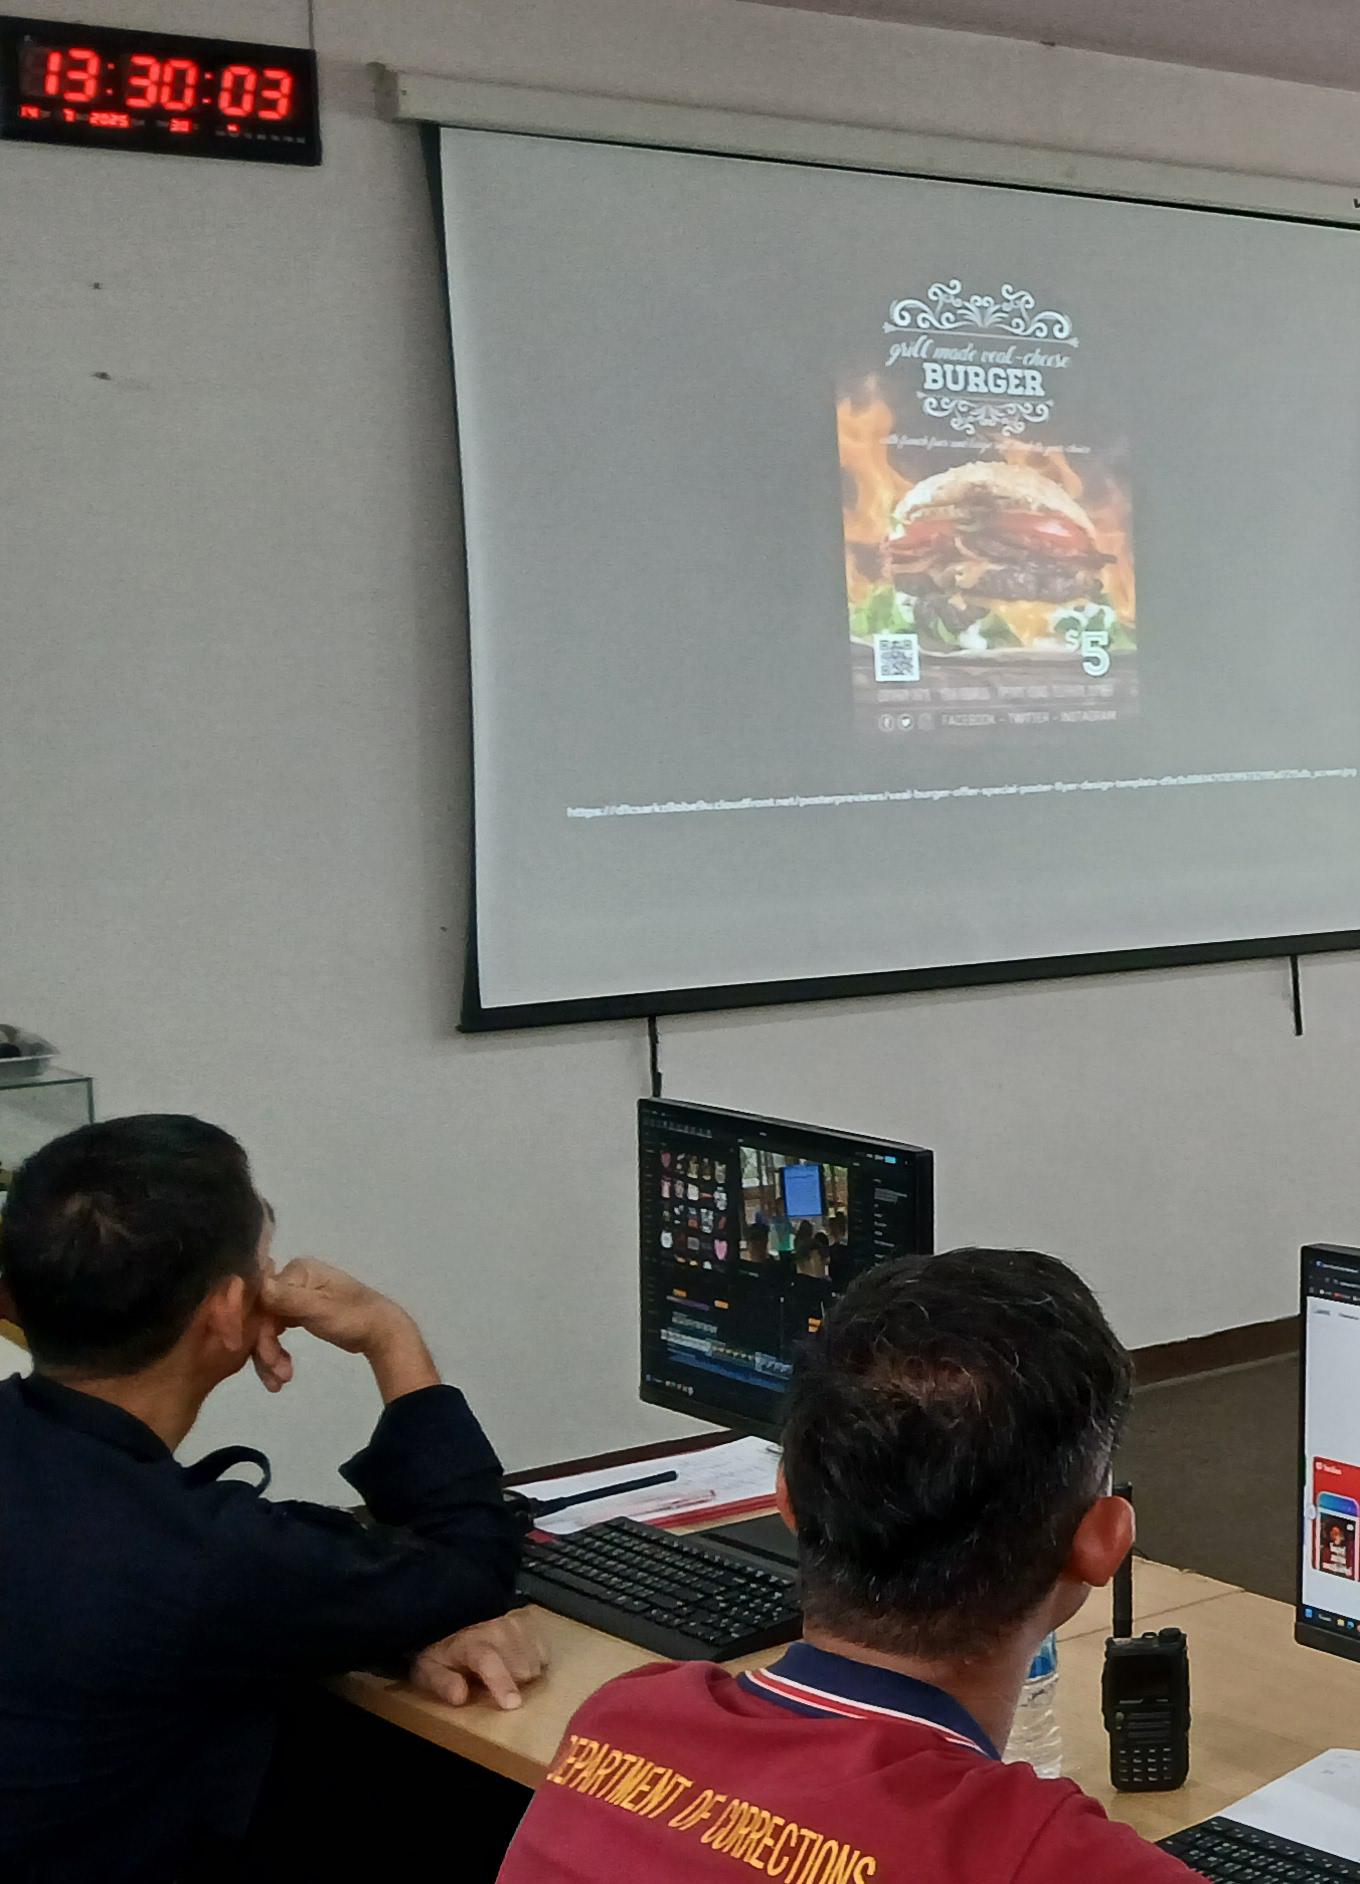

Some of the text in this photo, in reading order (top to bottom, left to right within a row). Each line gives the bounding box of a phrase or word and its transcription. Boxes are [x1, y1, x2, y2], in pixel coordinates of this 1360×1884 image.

[44, 47, 293, 120] 13:30:03
[886, 334, 933, 367] grill
[922, 362, 1045, 396] BURGER
[668, 1788, 727, 1832] OF
[699, 1799, 877, 1884] CORRECTIONS
